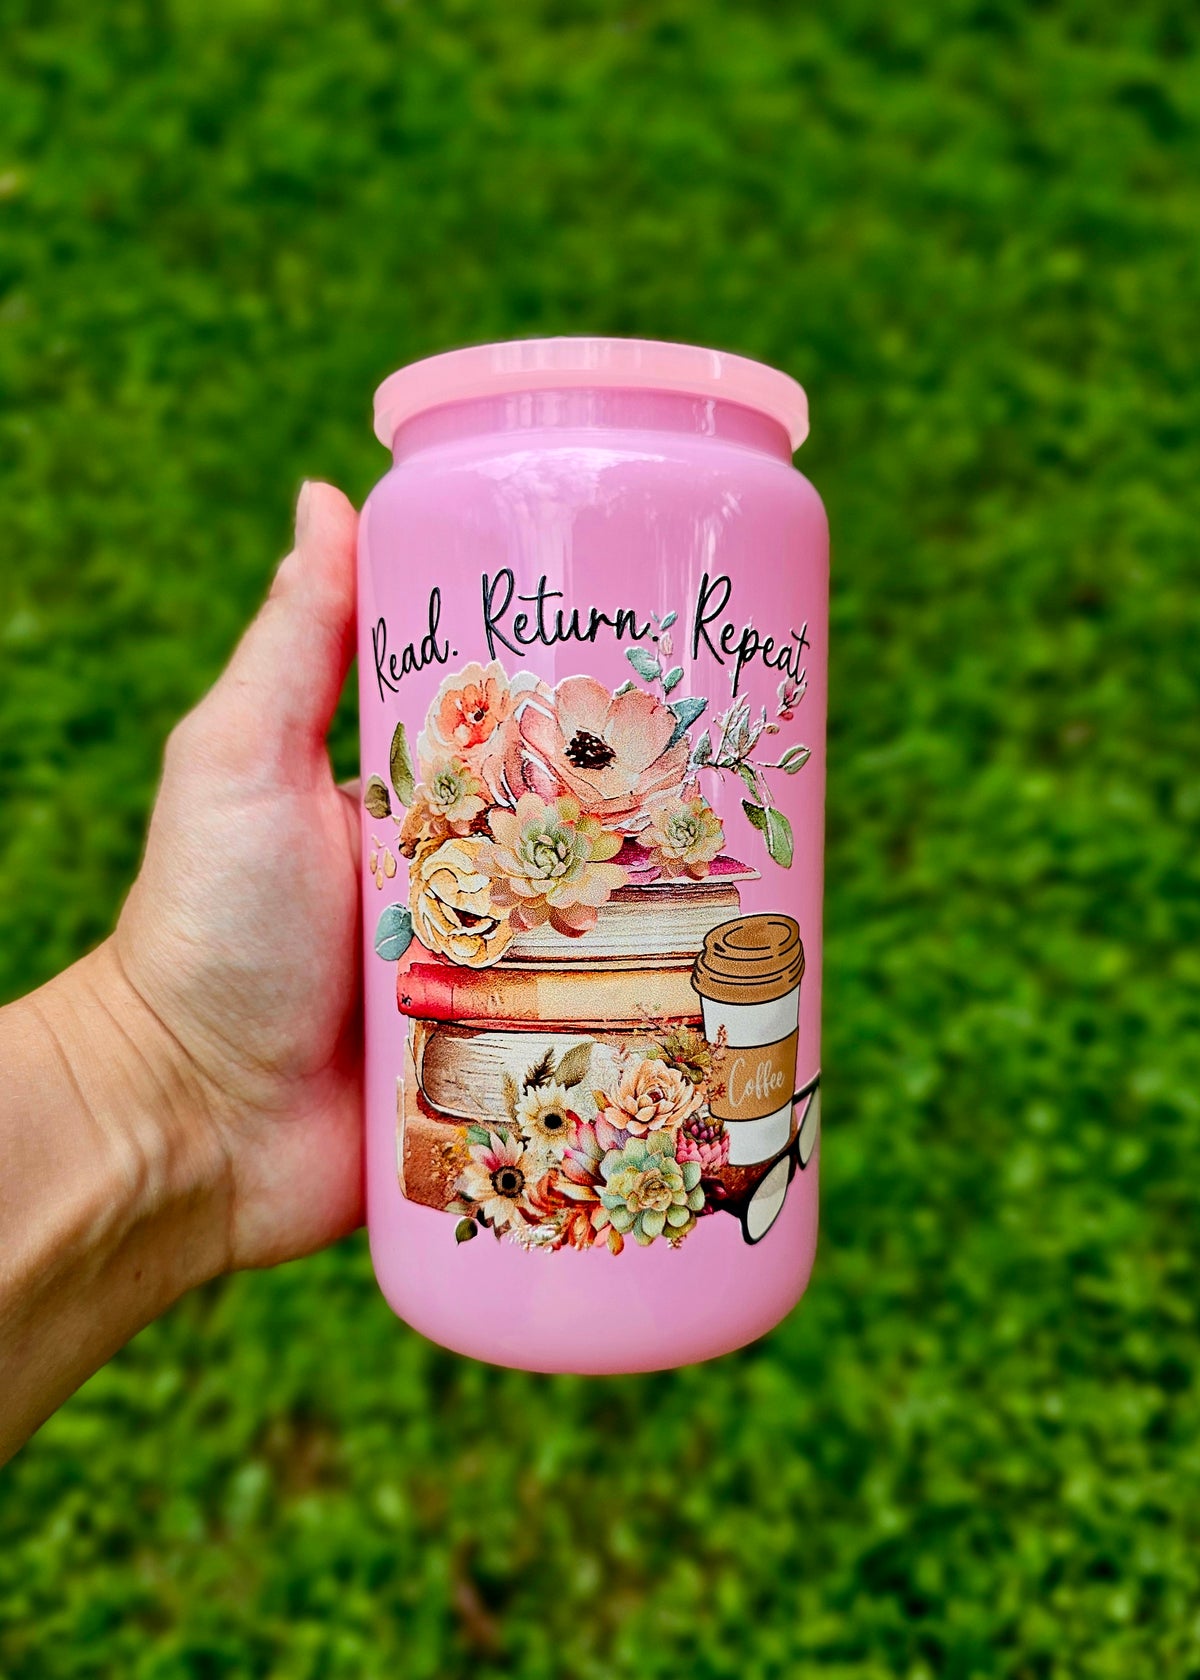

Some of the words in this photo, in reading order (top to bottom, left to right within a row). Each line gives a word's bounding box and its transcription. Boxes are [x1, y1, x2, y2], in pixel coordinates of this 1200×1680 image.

[371, 587, 458, 702] Read.
[481, 568, 660, 659] Return.
[728, 1057, 785, 1107] Coffee
